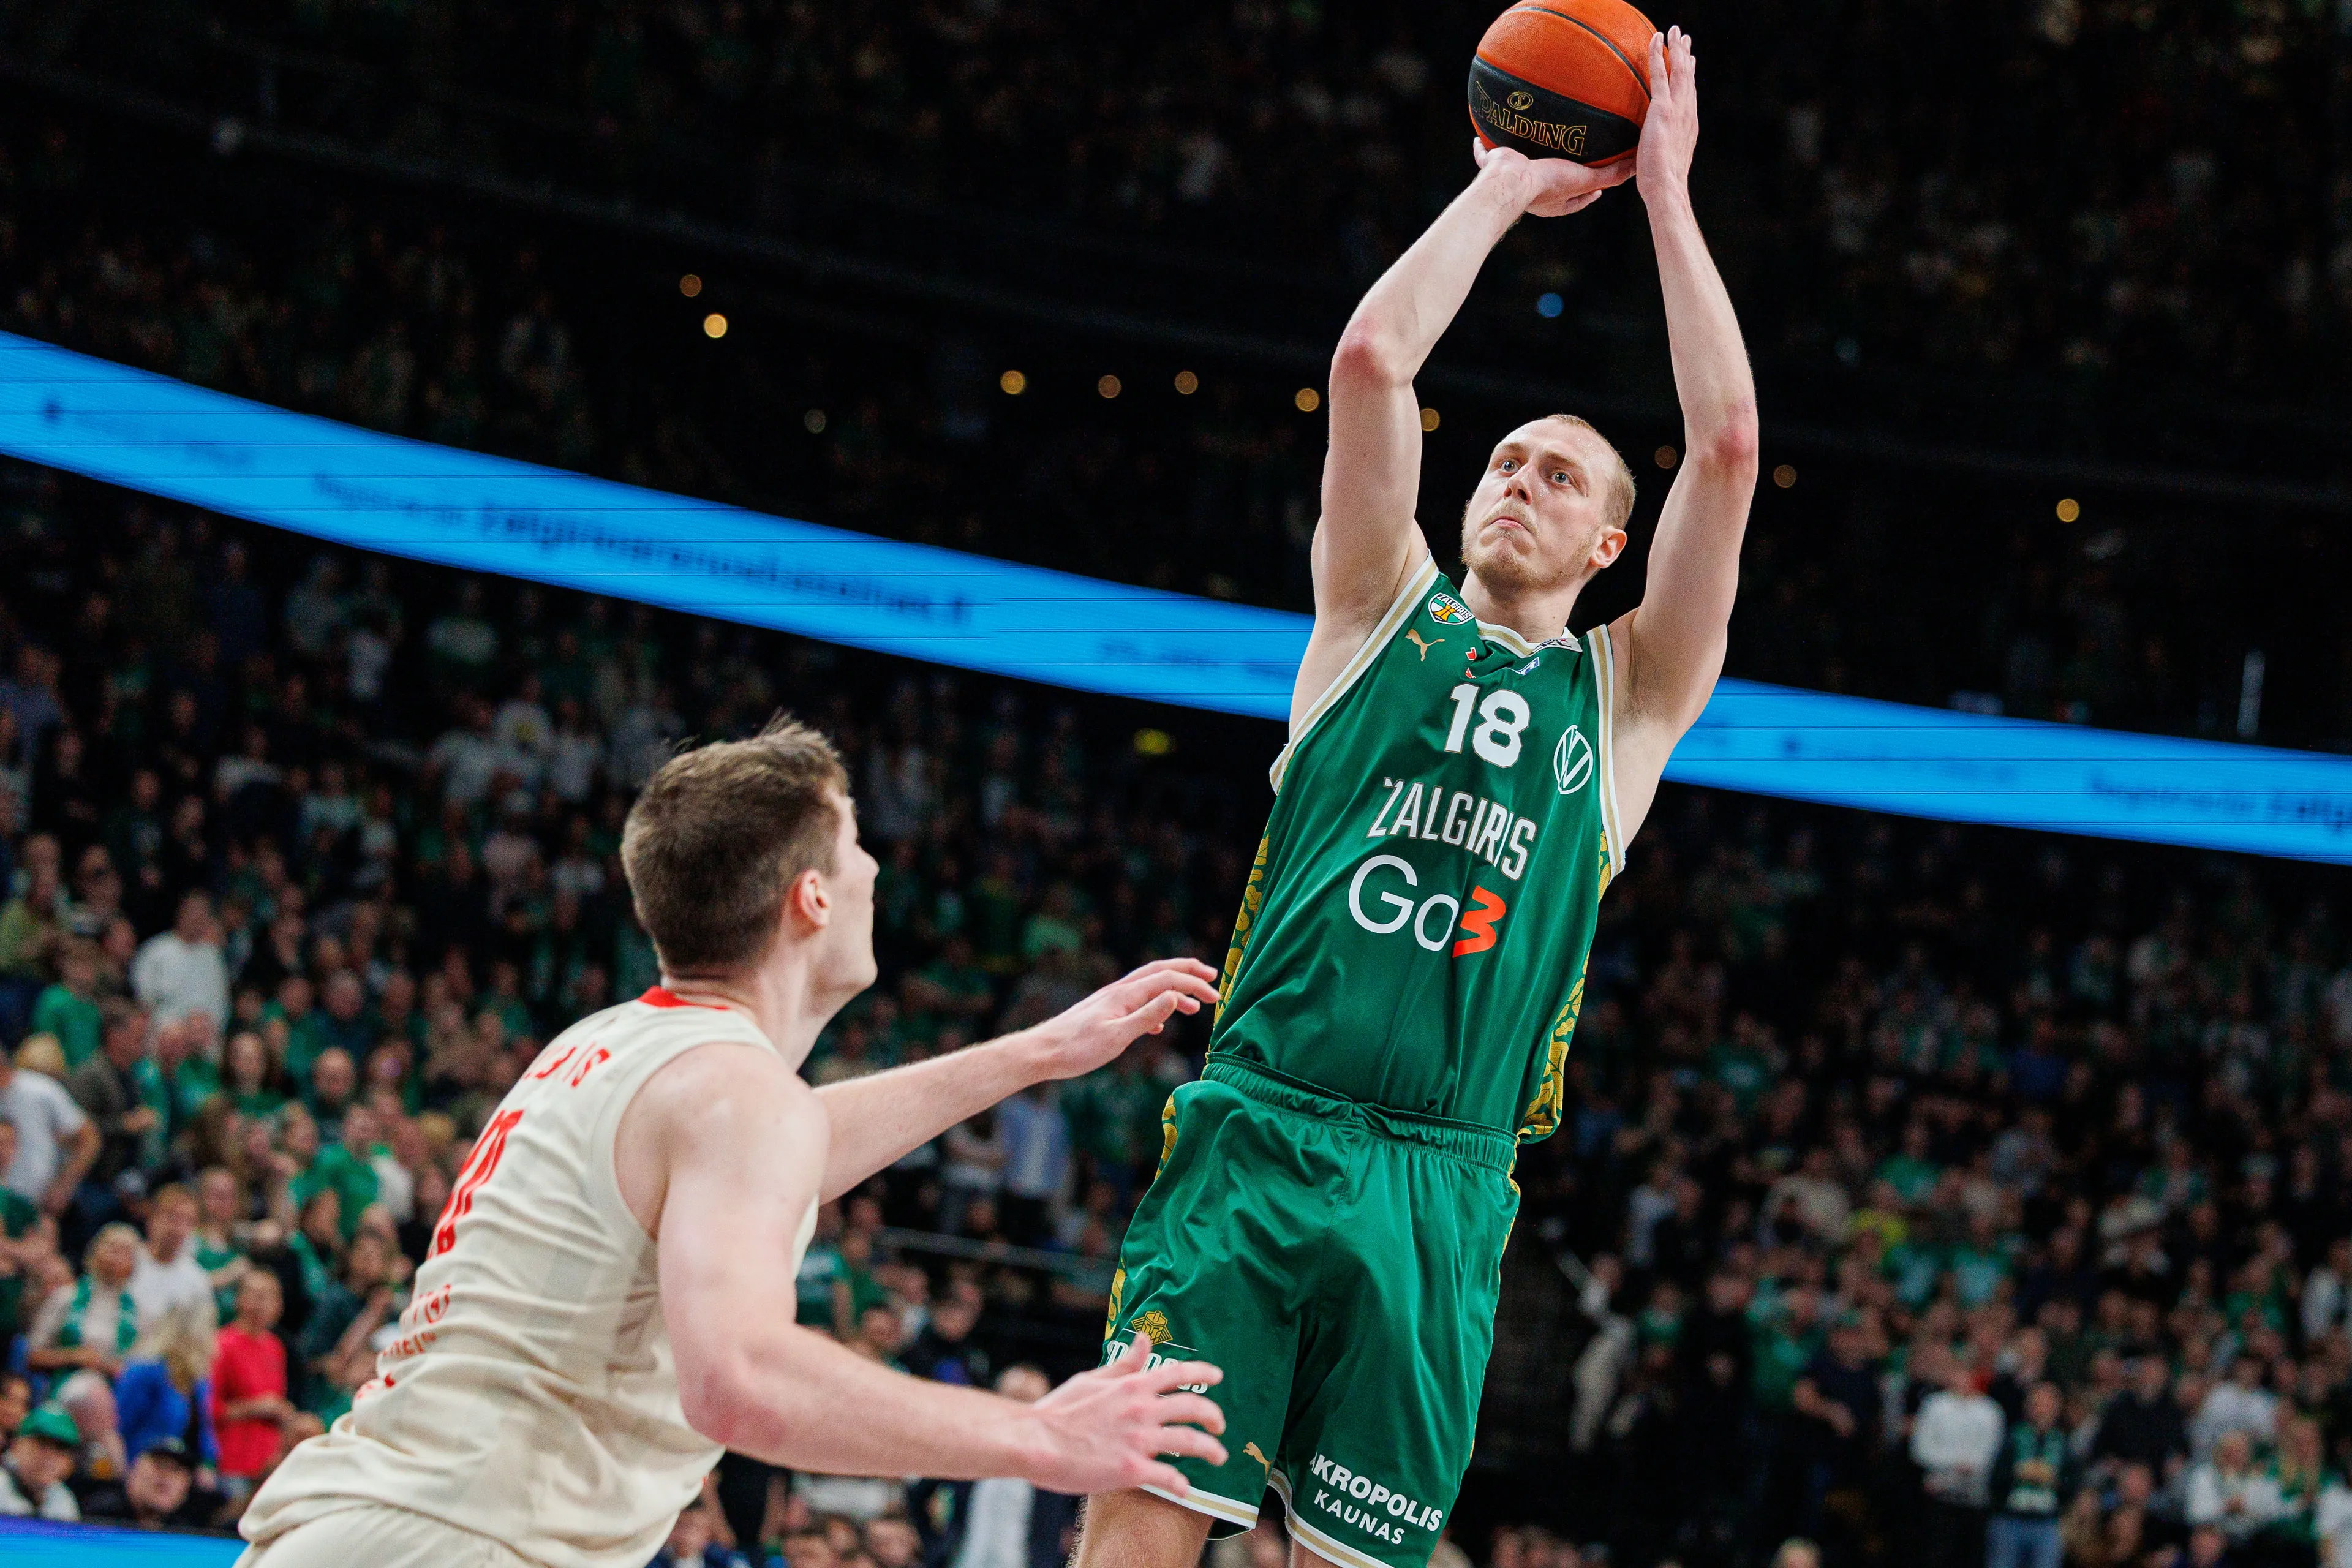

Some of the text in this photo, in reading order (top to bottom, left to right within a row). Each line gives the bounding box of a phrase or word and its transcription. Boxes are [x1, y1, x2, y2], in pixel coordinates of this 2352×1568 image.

[1472, 80, 1587, 156] PALDING
[1444, 682, 1530, 769] 18
[1314, 1489, 1405, 1545] KAUNAS
